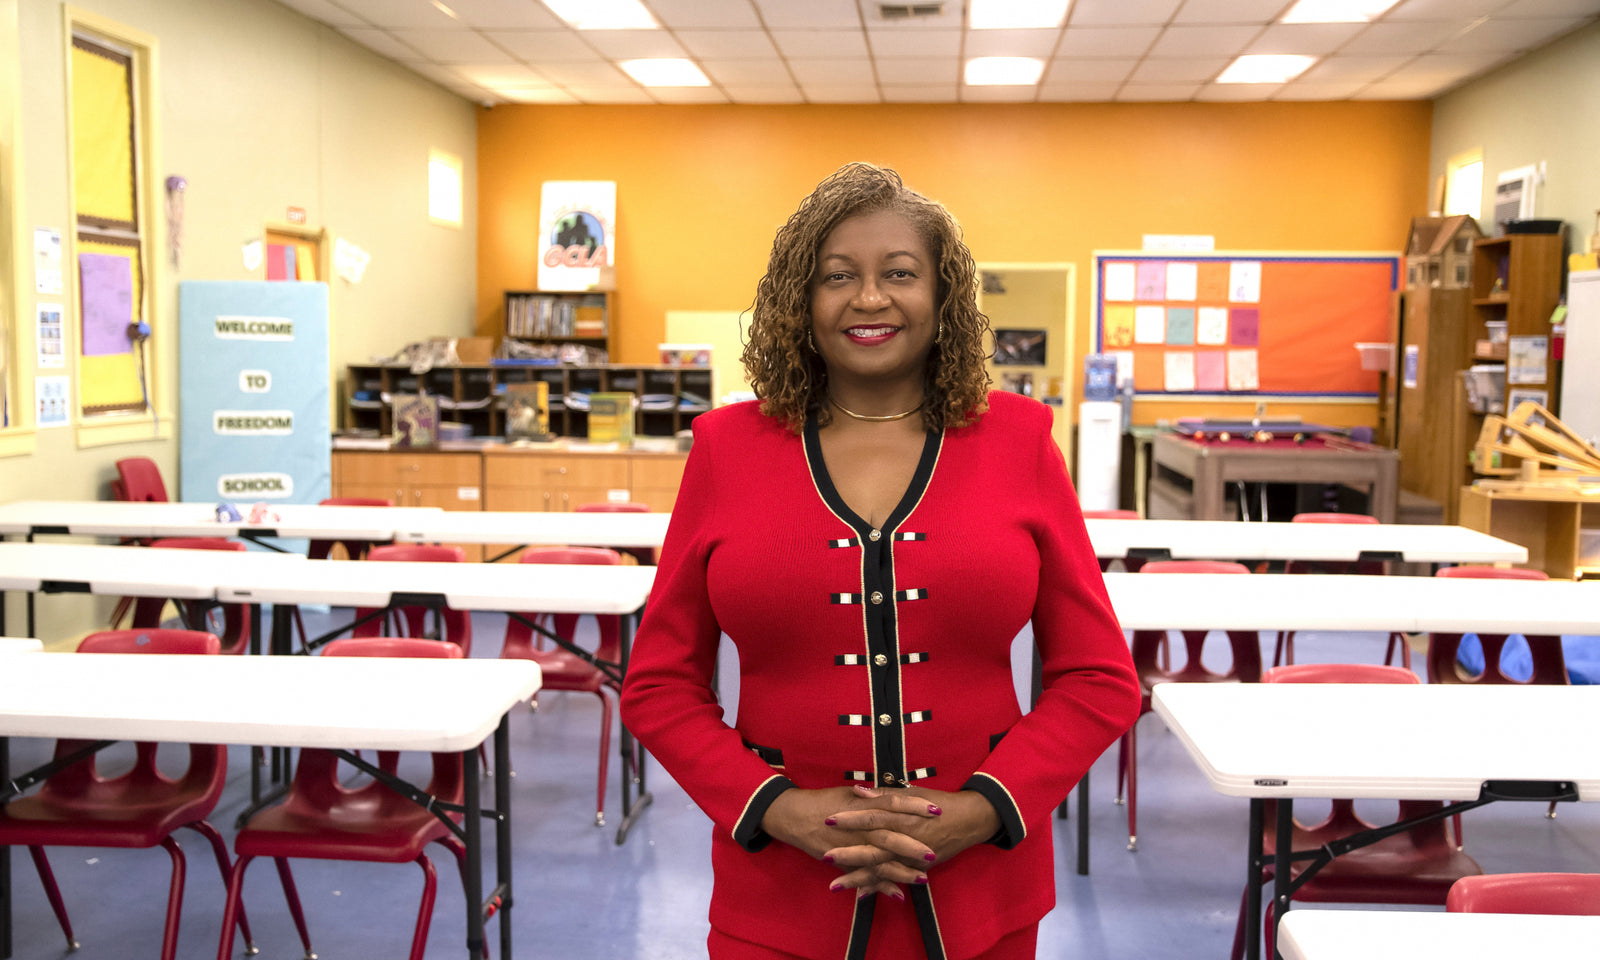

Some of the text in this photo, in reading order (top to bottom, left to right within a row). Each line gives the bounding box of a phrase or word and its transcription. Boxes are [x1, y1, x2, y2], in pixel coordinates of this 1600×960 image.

[215, 320, 293, 335] WELCOME
[245, 374, 267, 389] TO
[217, 415, 292, 430] FREEDOM
[223, 478, 285, 493] SCHOOL
